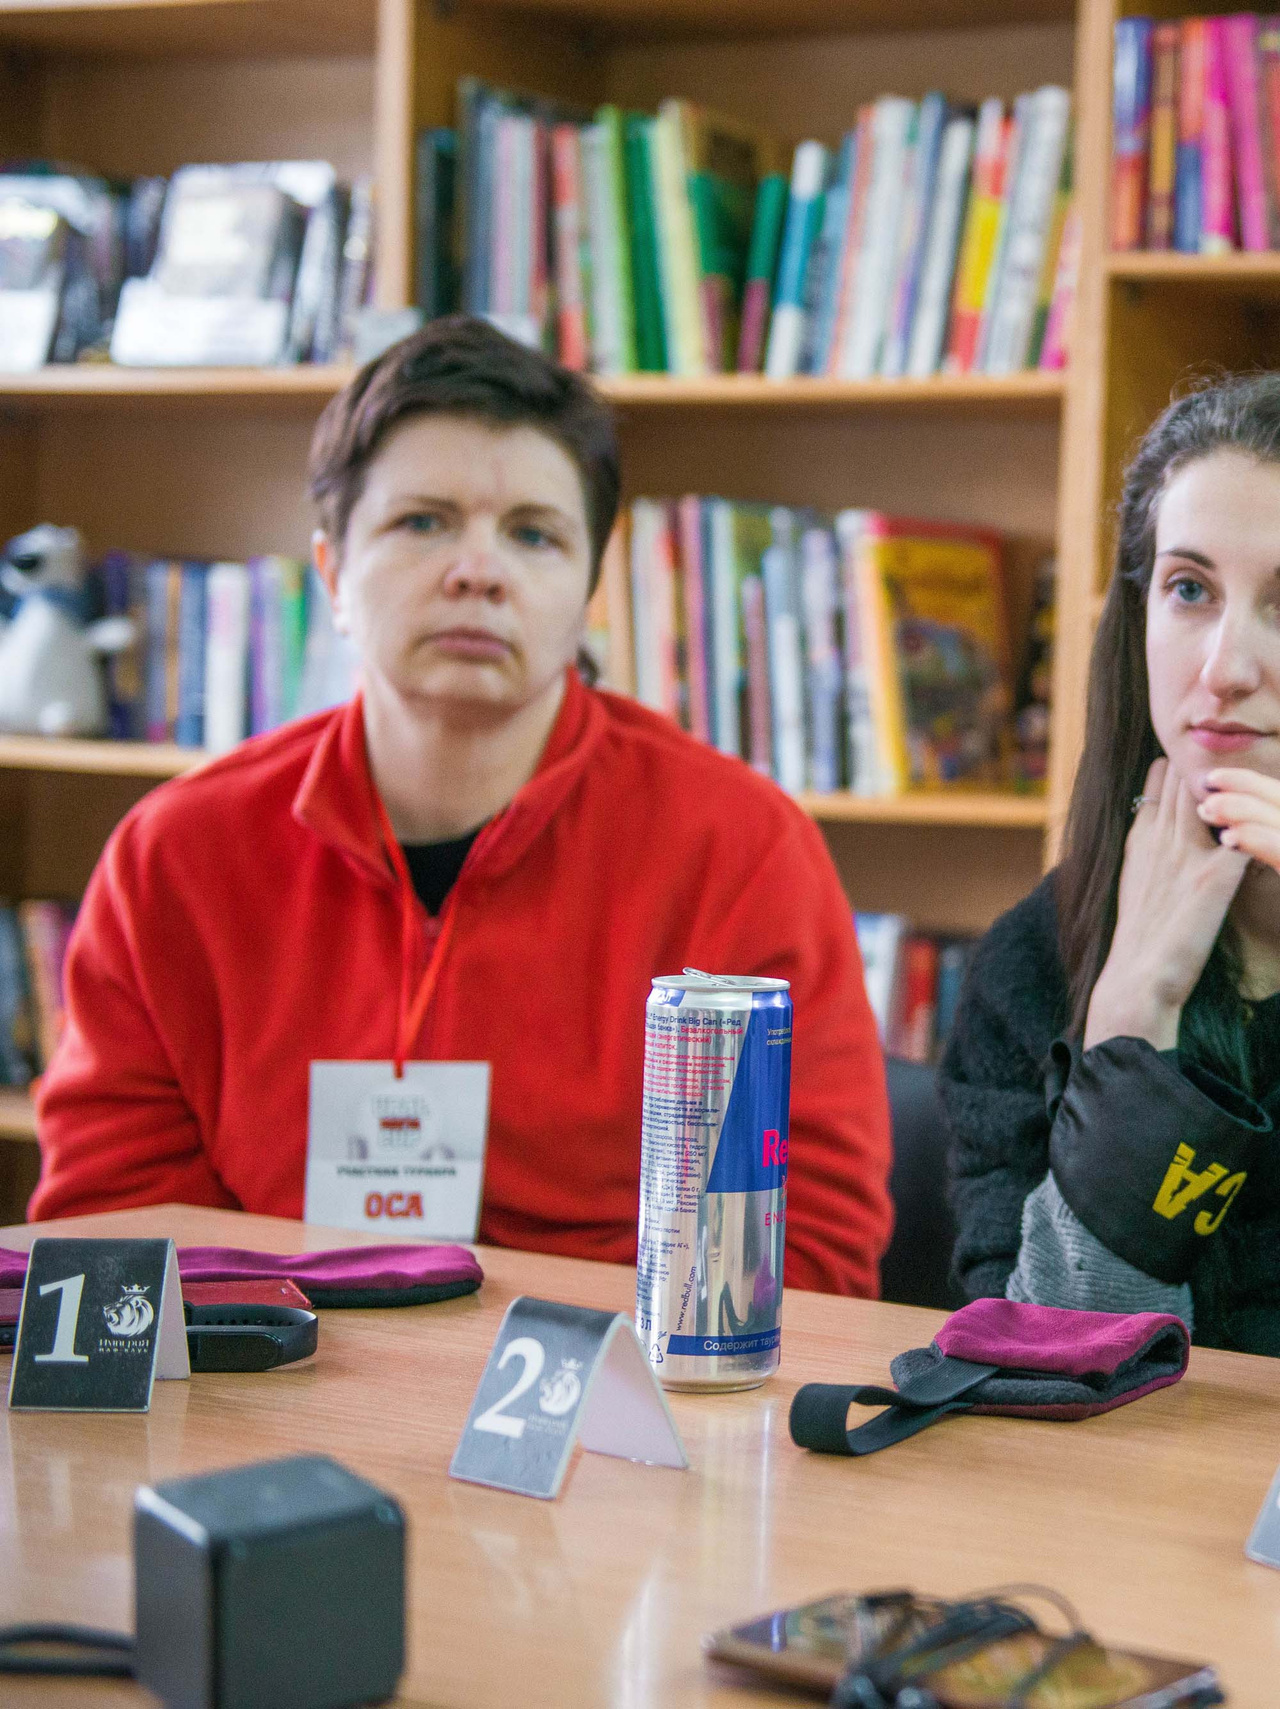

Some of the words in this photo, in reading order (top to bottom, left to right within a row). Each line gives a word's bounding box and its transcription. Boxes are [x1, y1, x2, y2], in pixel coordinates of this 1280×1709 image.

[669, 1015, 687, 1025] Drink
[688, 1016, 701, 1026] Big
[702, 1017, 718, 1026] Can
[680, 1025, 744, 1036] Безалкогольный
[762, 1129, 788, 1168] Re
[365, 1192, 424, 1219] ОСА
[676, 1265, 697, 1332] www.redbull.com
[34, 1273, 89, 1363] 1
[703, 1338, 758, 1352] Содержит
[473, 1336, 546, 1440] 2
